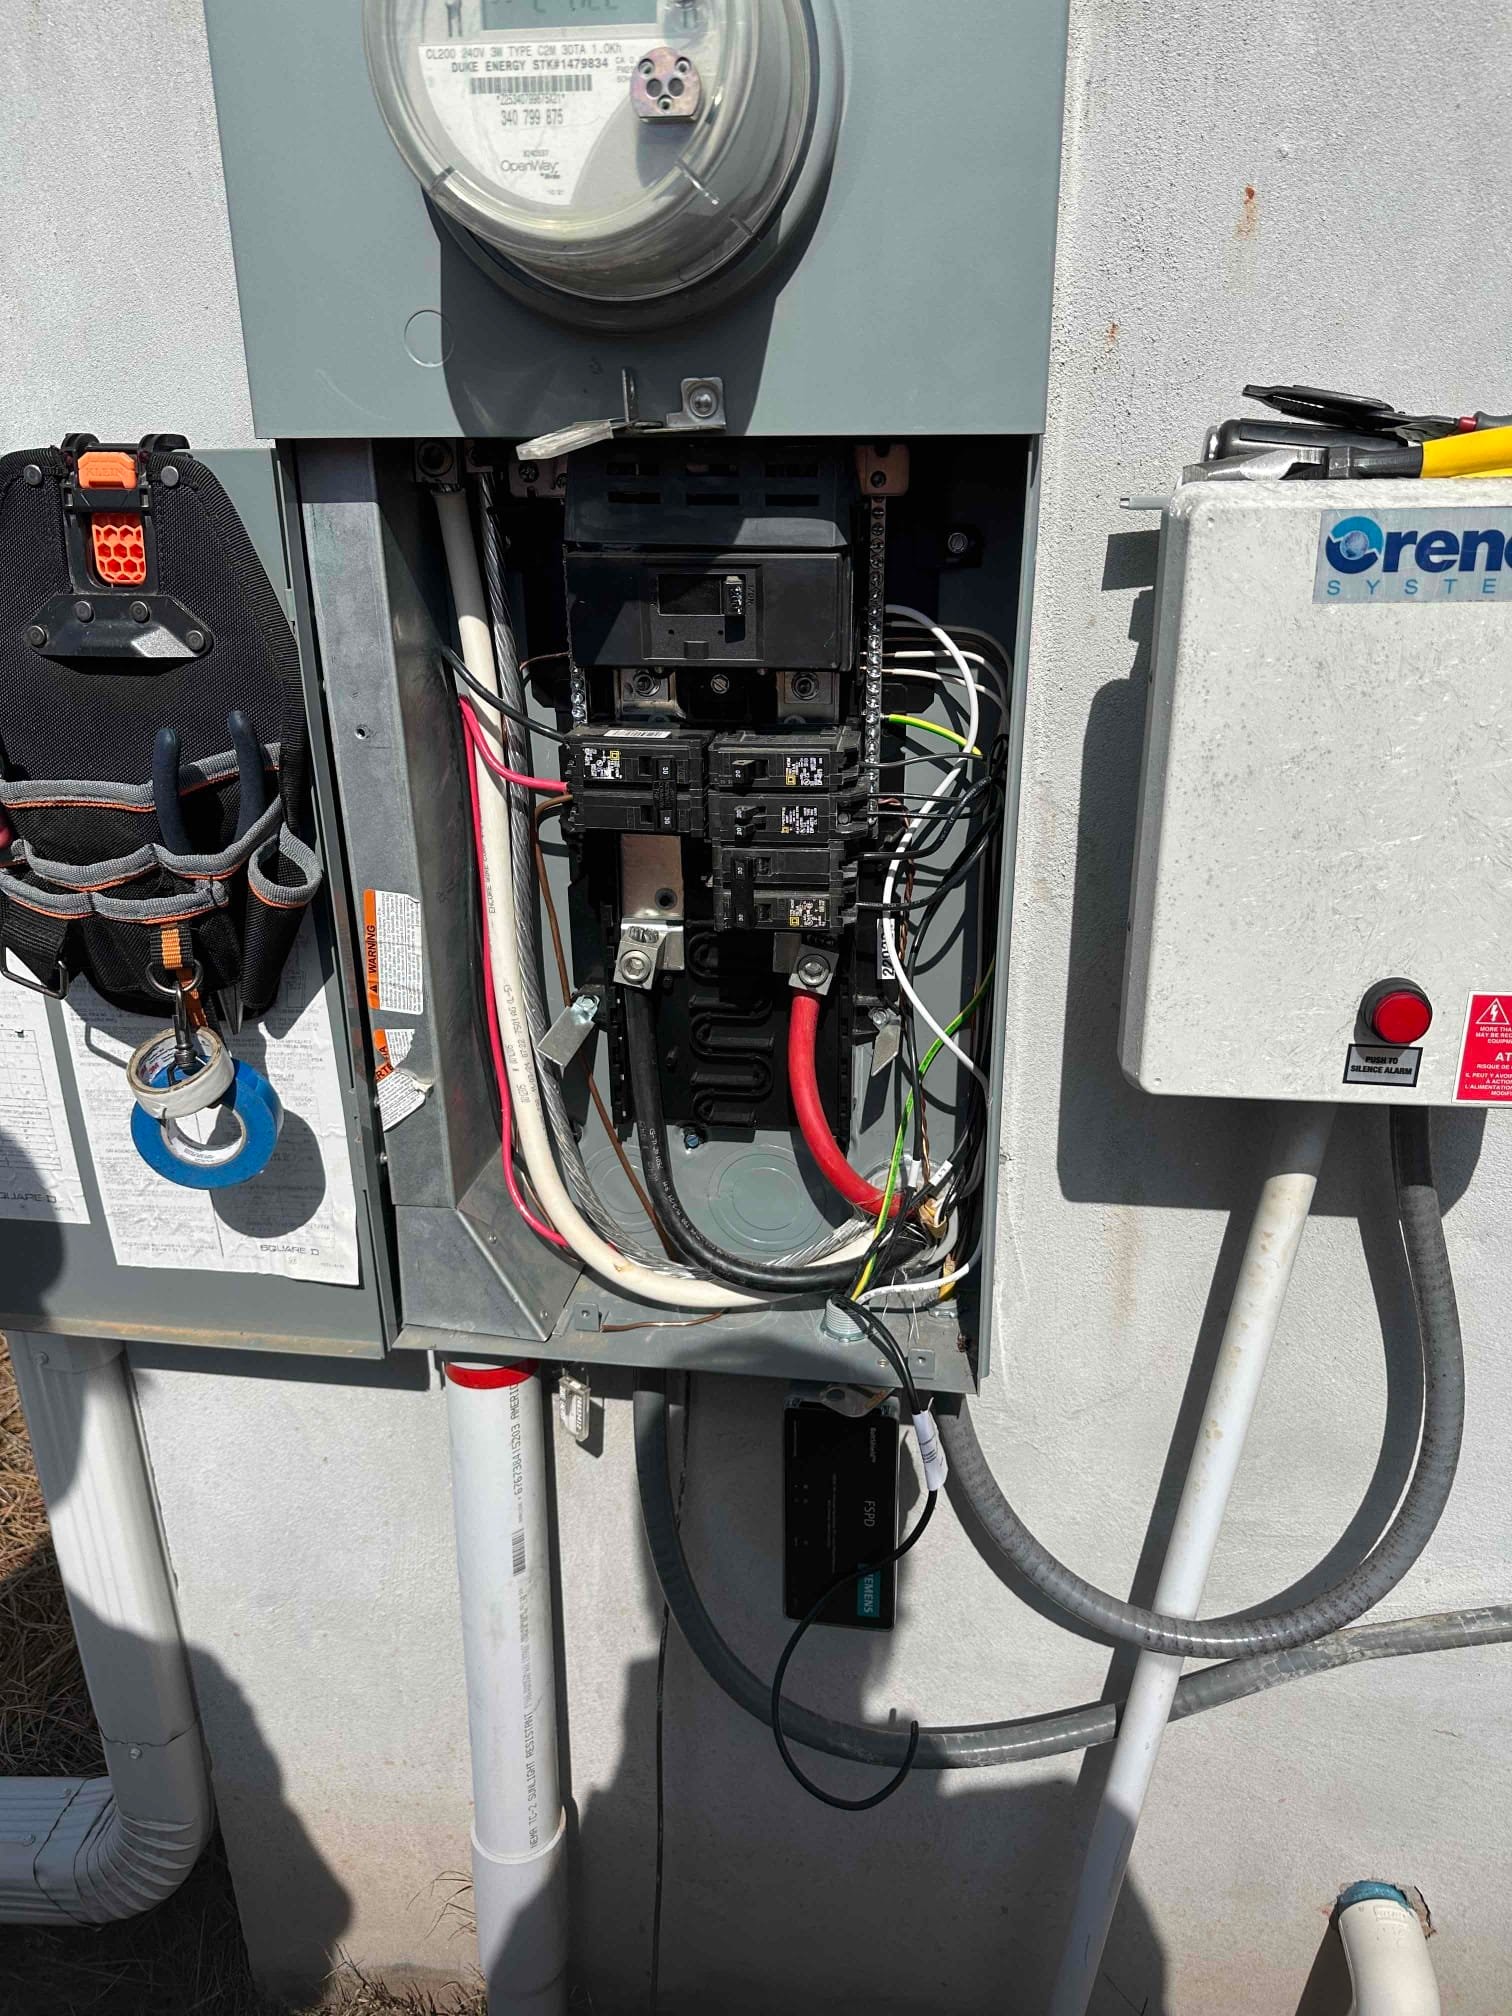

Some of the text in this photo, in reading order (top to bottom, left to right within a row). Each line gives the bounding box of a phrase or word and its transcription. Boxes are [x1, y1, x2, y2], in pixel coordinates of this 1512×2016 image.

[508, 45, 532, 57] TYPE
[451, 60, 479, 73] DUKE
[485, 59, 526, 72] ENERGY
[501, 110, 518, 126] 340
[500, 159, 559, 174] OpenWay
[1325, 515, 1512, 574] Oren
[368, 924, 377, 974] WARNING
[1350, 1065, 1413, 1075] SILENCE ALARM
[1365, 1056, 1398, 1065] PUSH TO
[260, 1244, 320, 1256] SQUARE D
[863, 1500, 875, 1527] FSPD
[863, 1572, 874, 1614] EMENS
[524, 1710, 535, 1758] RESISTANT
[526, 1760, 537, 1802] SUNLIGHT
[528, 1802, 538, 1826] TC-2
[529, 1826, 538, 1849] NEMA
